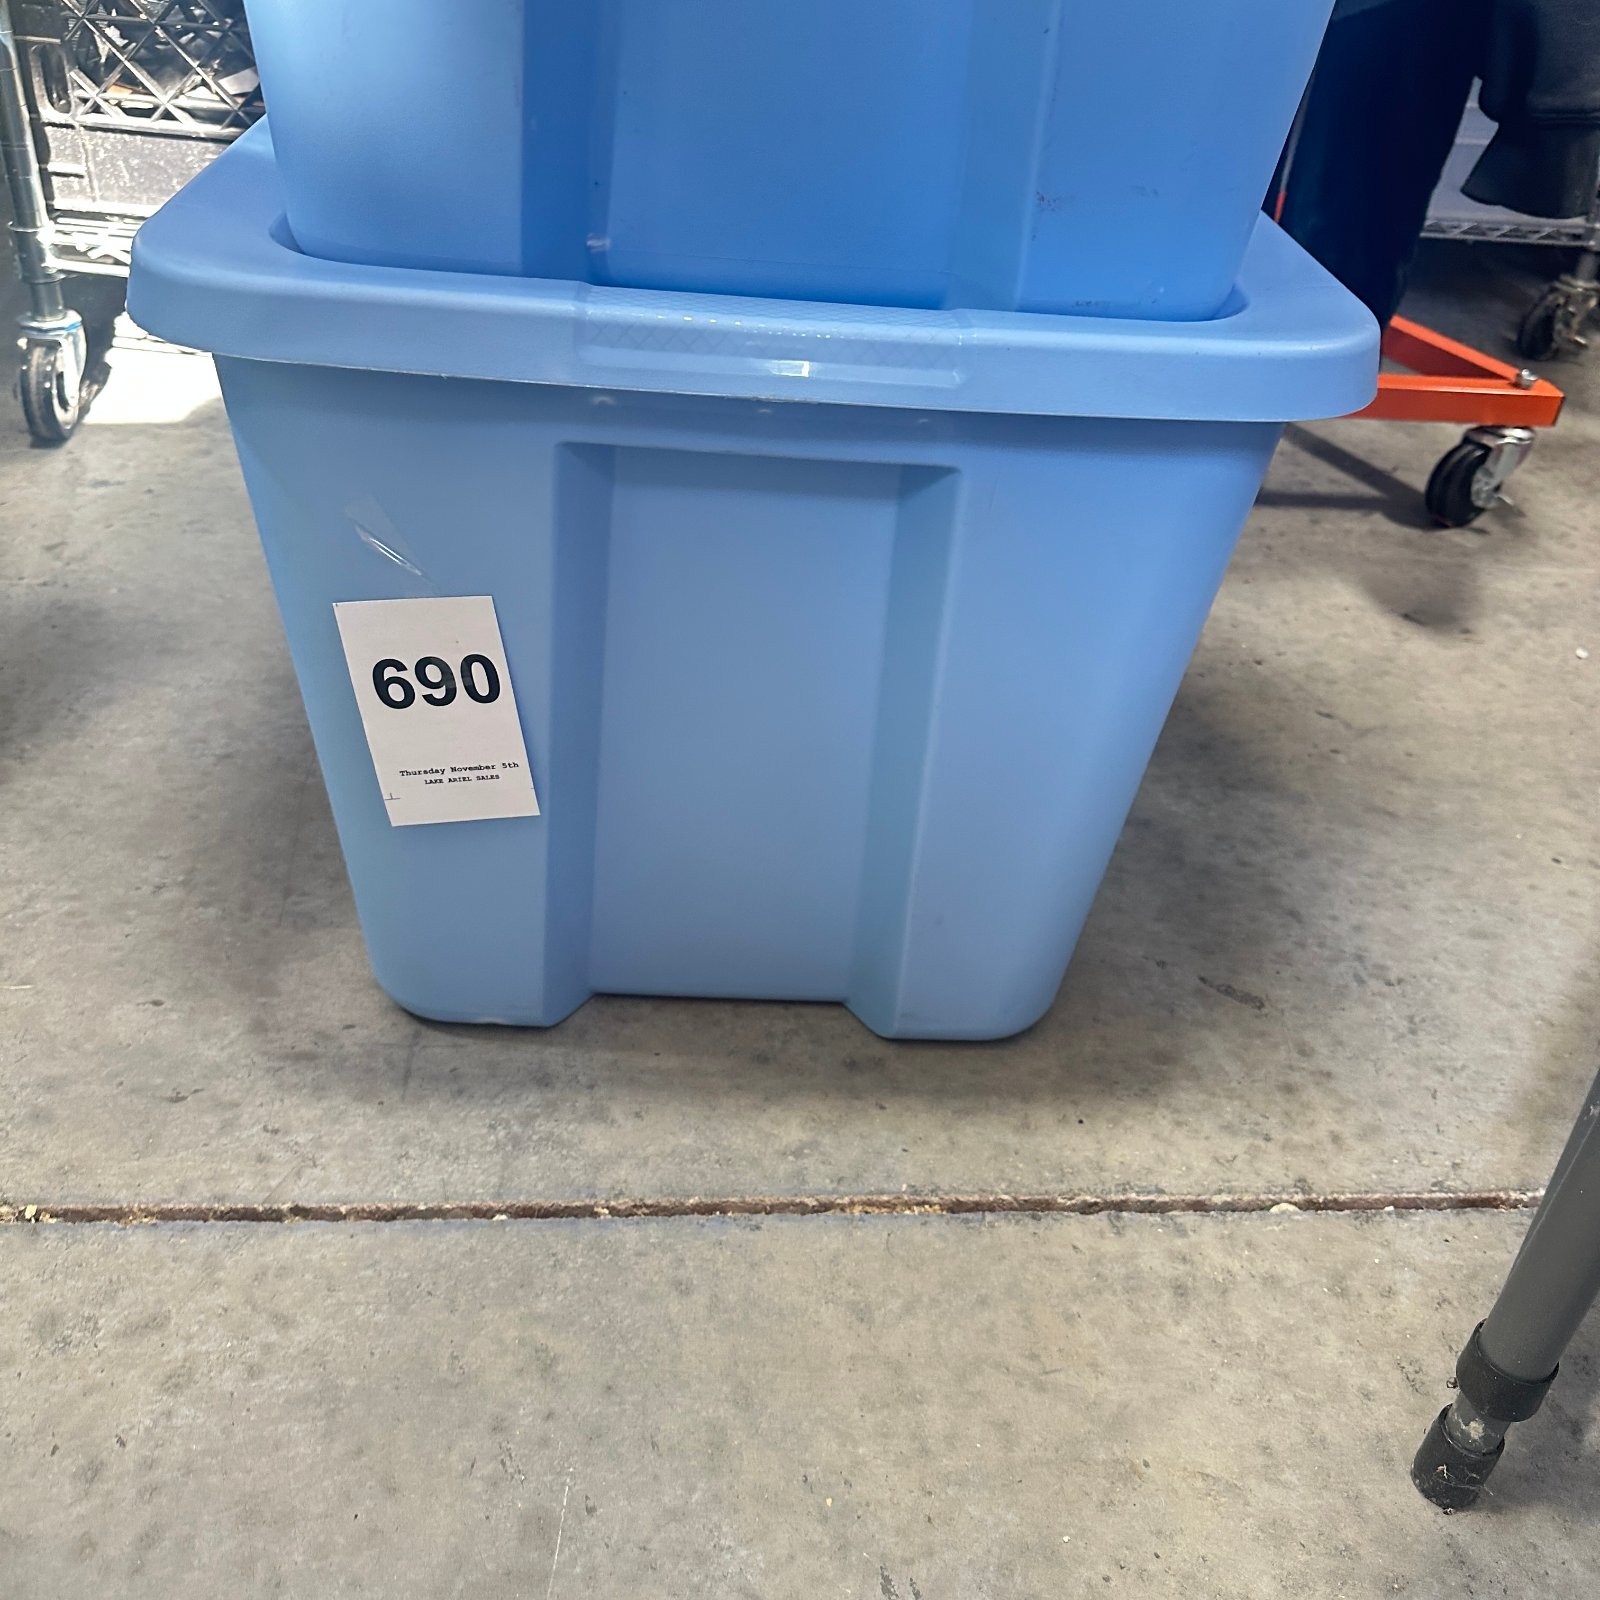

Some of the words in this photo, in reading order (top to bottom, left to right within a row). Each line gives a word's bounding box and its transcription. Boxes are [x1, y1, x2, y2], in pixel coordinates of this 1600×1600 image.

[372, 653, 501, 710] 690
[399, 767, 446, 777] Thursday
[450, 763, 496, 773] November
[501, 761, 519, 769] 5th
